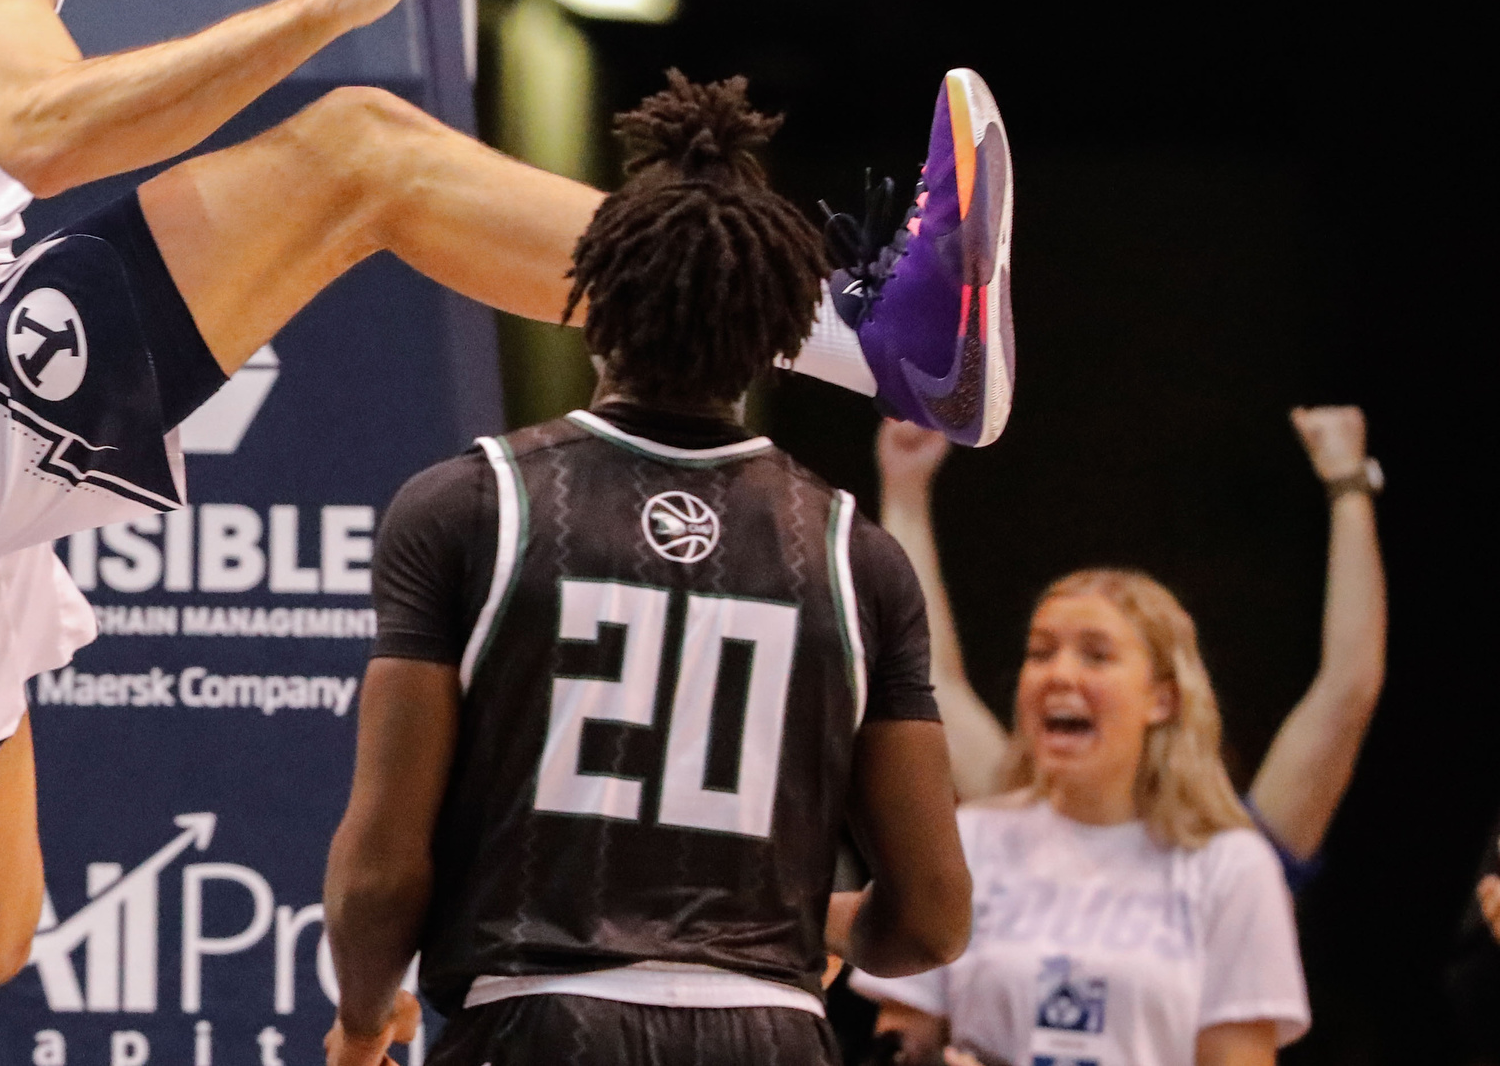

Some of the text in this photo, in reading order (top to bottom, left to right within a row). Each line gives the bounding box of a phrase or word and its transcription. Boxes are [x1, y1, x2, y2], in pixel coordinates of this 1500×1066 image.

[65, 503, 375, 594] ISIBLE
[37, 666, 174, 706] Maersk
[179, 666, 357, 716] Company
[533, 579, 799, 839] 20
